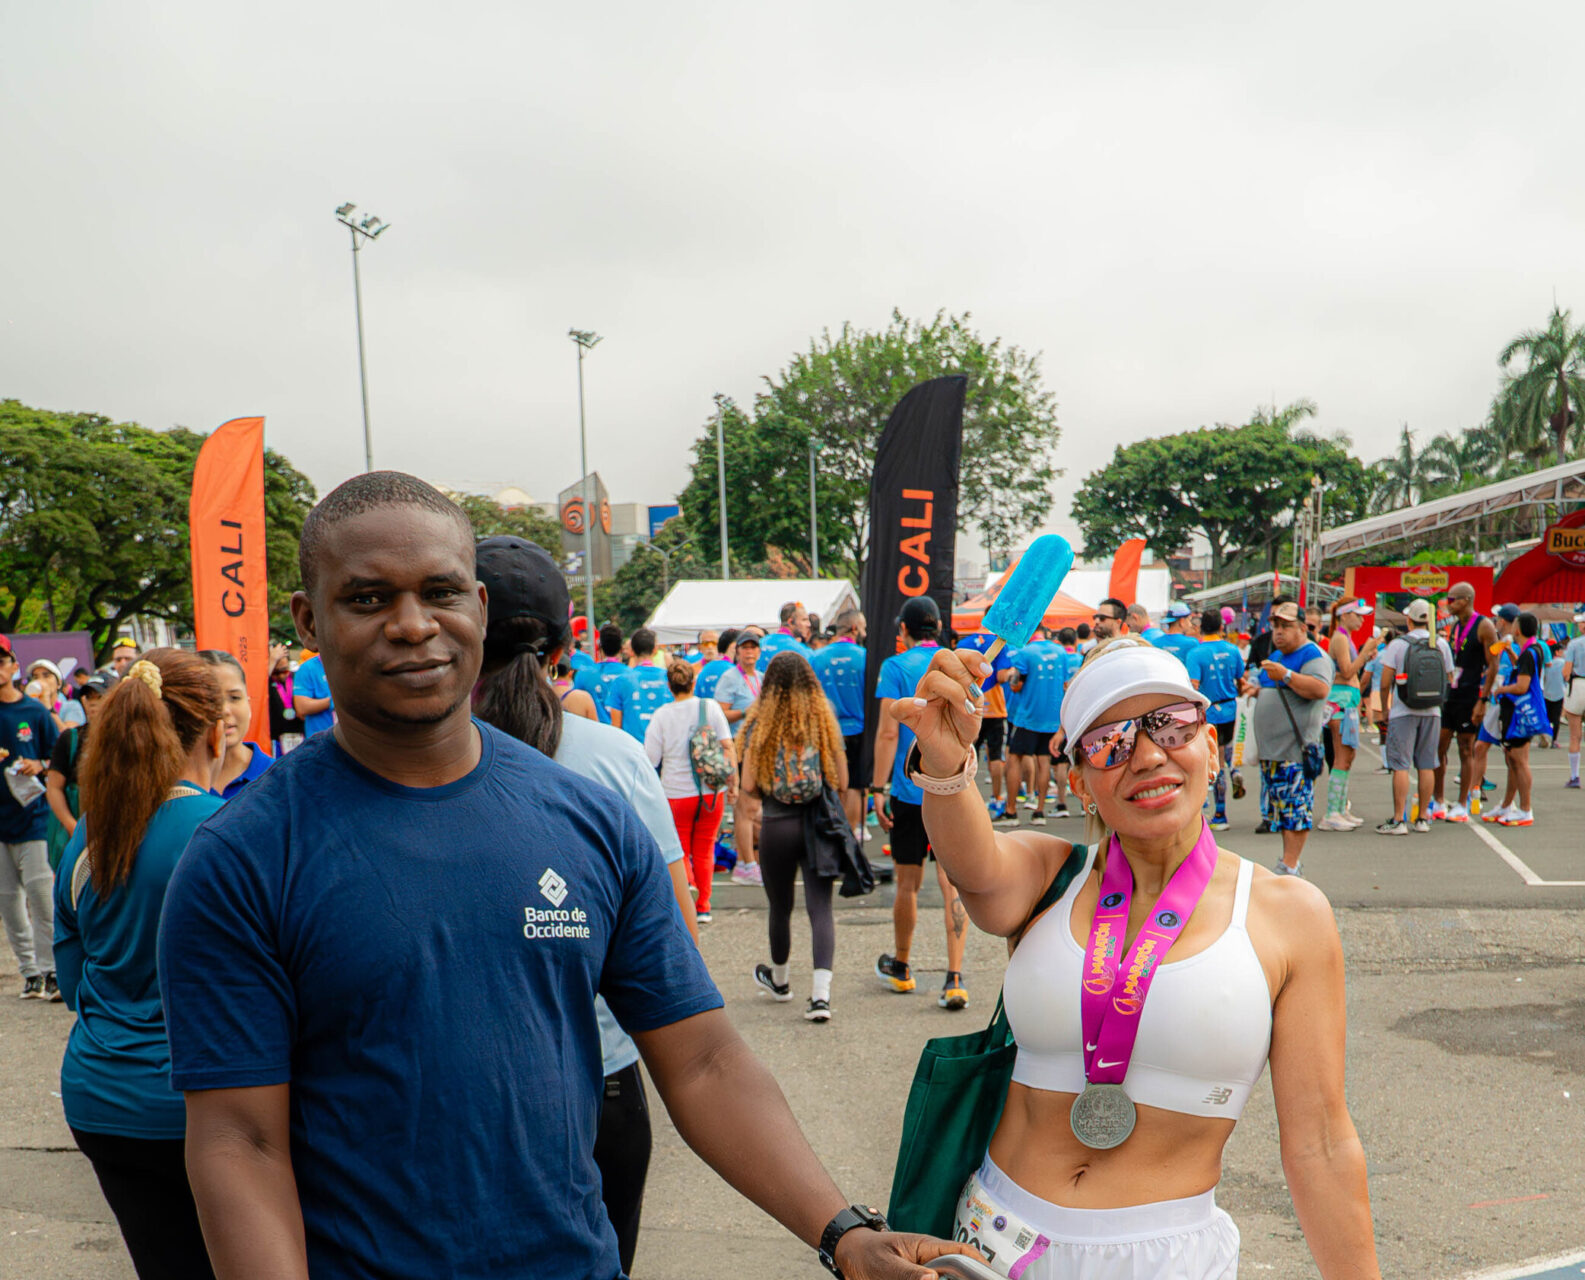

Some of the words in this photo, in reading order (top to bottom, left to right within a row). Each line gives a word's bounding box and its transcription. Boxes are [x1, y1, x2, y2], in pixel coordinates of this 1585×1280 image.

[897, 489, 934, 597] CALI
[1553, 532, 1585, 547] Buc
[220, 519, 246, 617] CALI
[1404, 575, 1446, 585] Bucanero
[523, 922, 591, 939] Occidente
[524, 907, 570, 922] Banco
[571, 907, 587, 922] de
[1090, 923, 1111, 974] MARATÓN
[1123, 939, 1158, 994] MARATÓN
